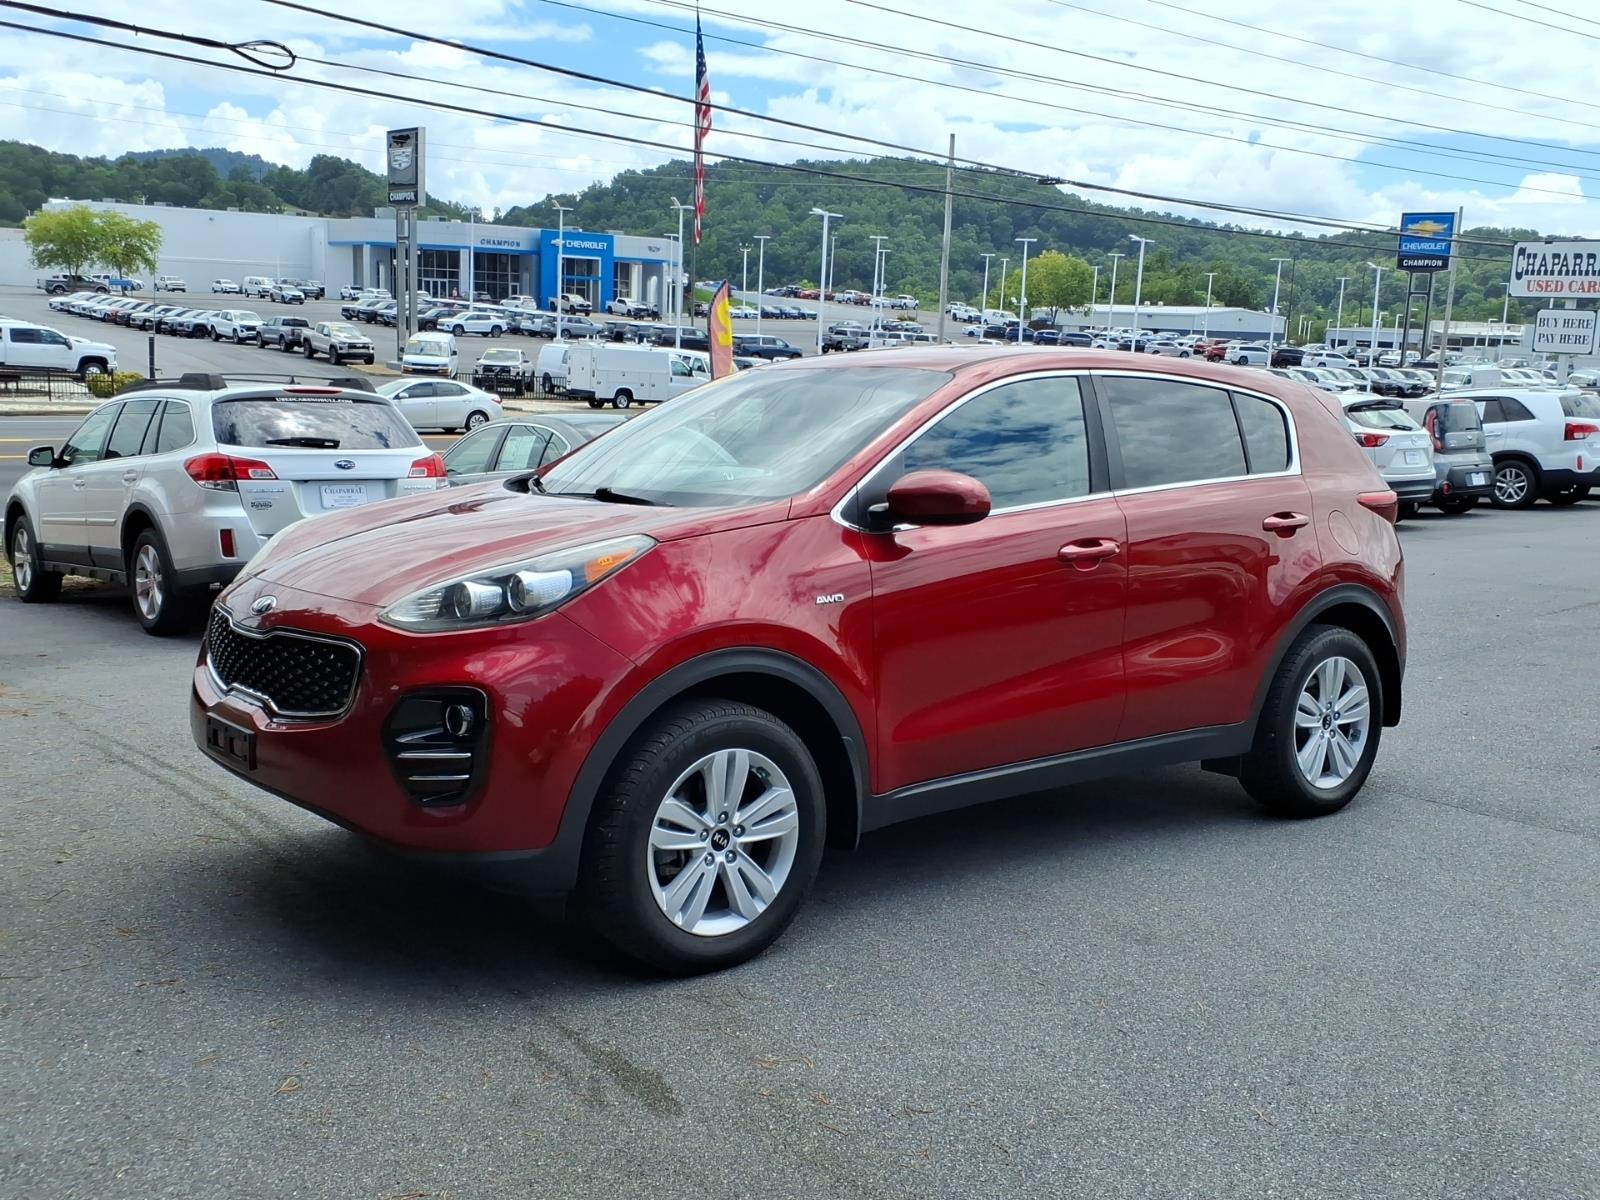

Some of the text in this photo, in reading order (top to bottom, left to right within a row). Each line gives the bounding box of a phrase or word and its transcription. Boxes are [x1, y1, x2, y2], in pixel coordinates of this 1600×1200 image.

[480, 238, 521, 248] CHAMPION
[566, 240, 608, 250] CHEVROLET
[1402, 242, 1447, 250] CHEVROLET
[1402, 259, 1443, 267] CHAMPION
[1515, 246, 1600, 280] CHAPARR
[1526, 280, 1564, 293] USED
[1538, 317, 1593, 329] BUY HERE
[1538, 333, 1590, 345] PAY HERE
[815, 593, 845, 604] AWD
[713, 832, 728, 848] KIA
